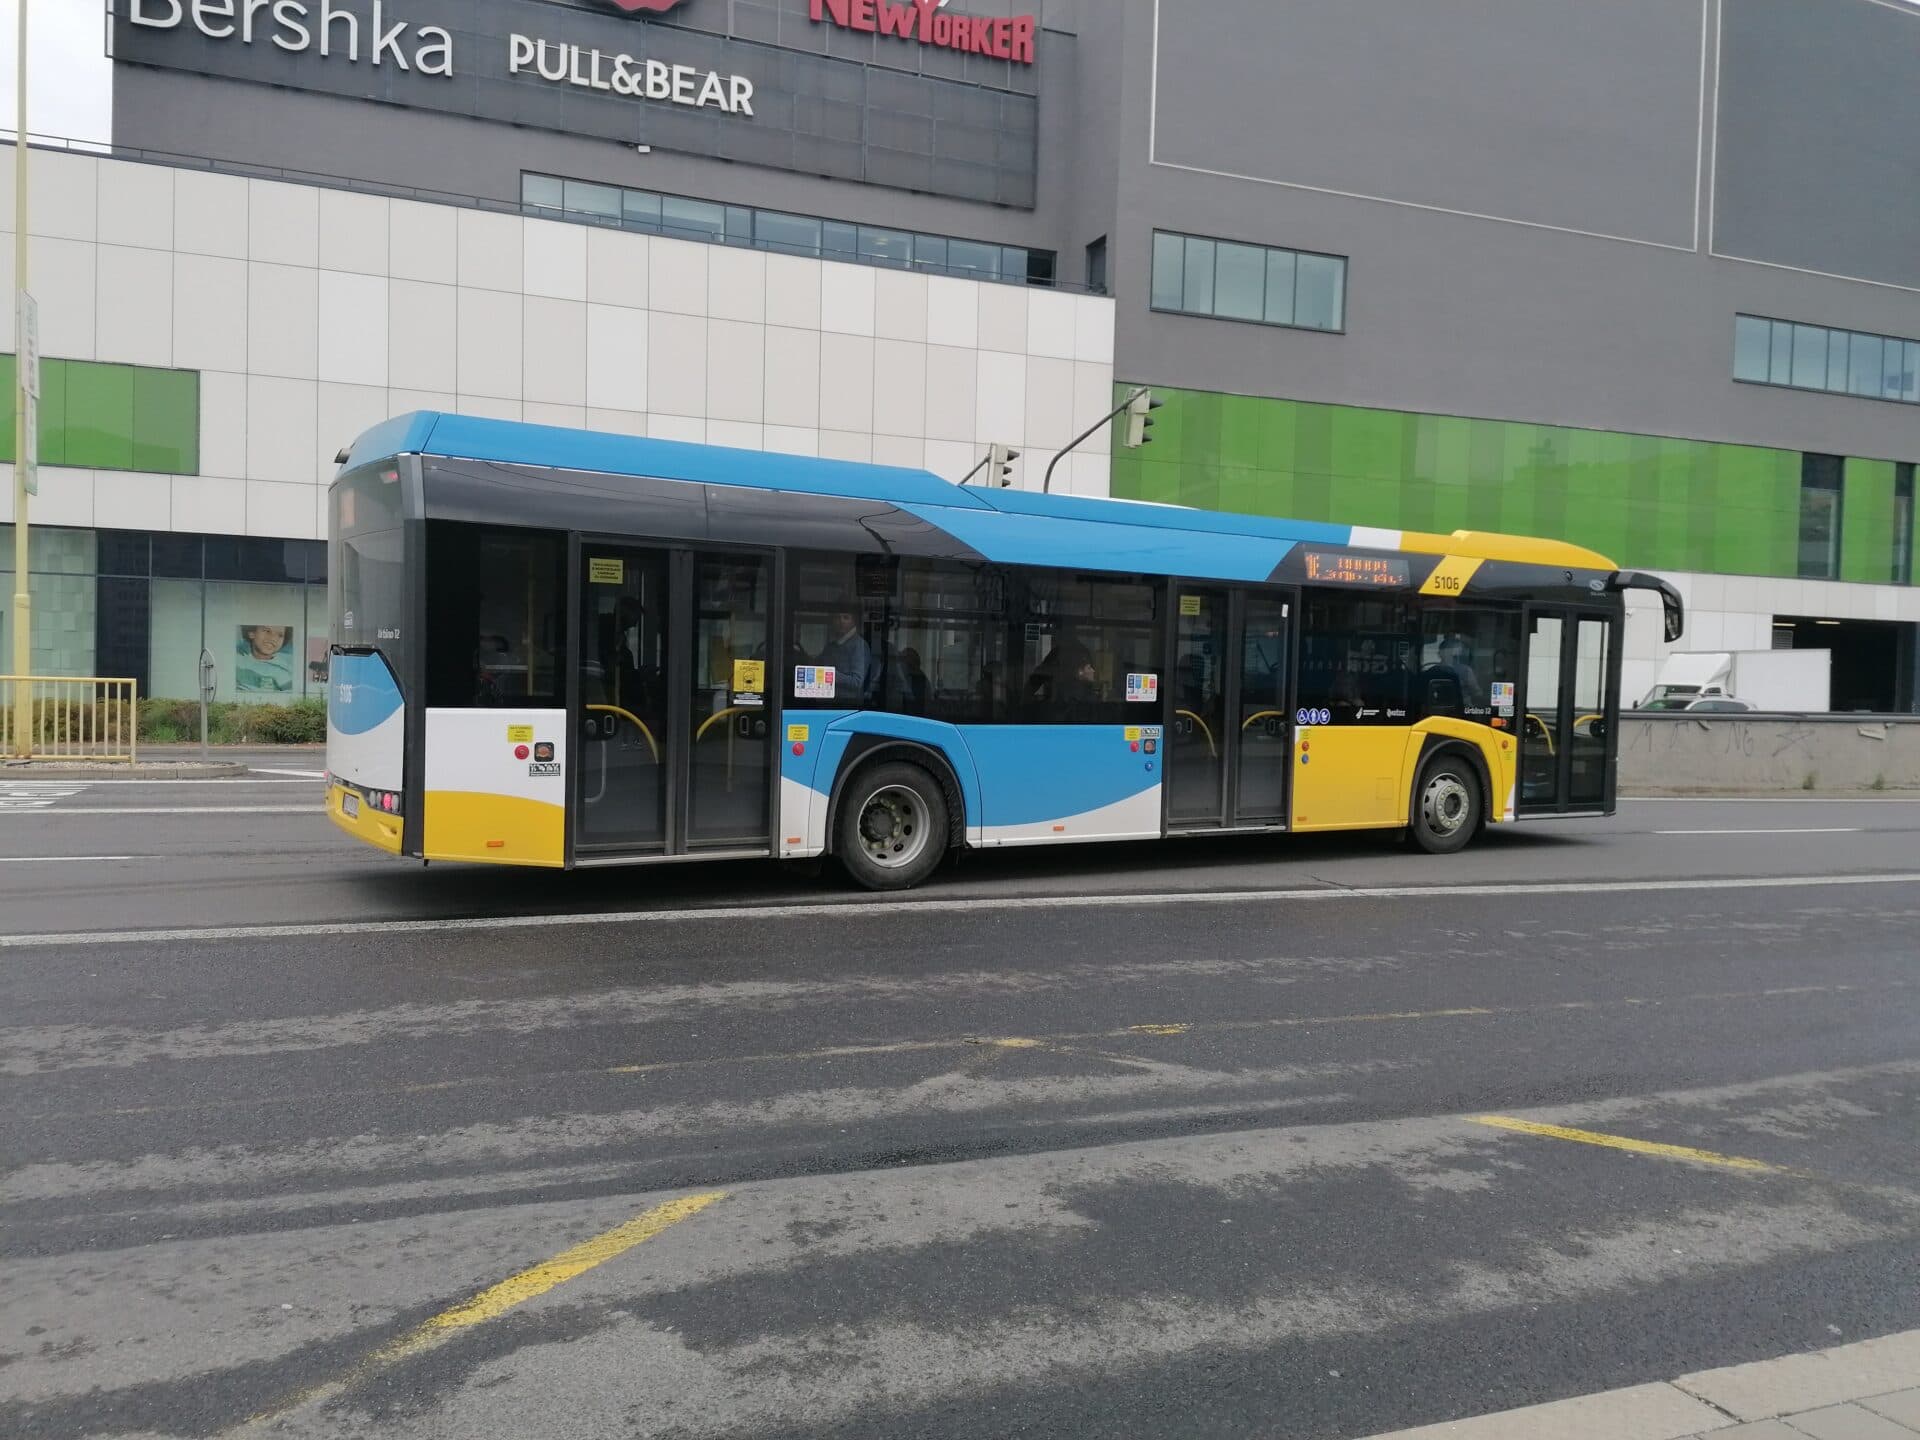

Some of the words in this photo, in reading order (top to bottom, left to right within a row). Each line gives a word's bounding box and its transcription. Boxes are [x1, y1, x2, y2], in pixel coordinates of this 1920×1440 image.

[509, 33, 754, 116] PULL&BEAR
[1434, 575, 1460, 590] 5106
[1485, 706, 1492, 715] 12
